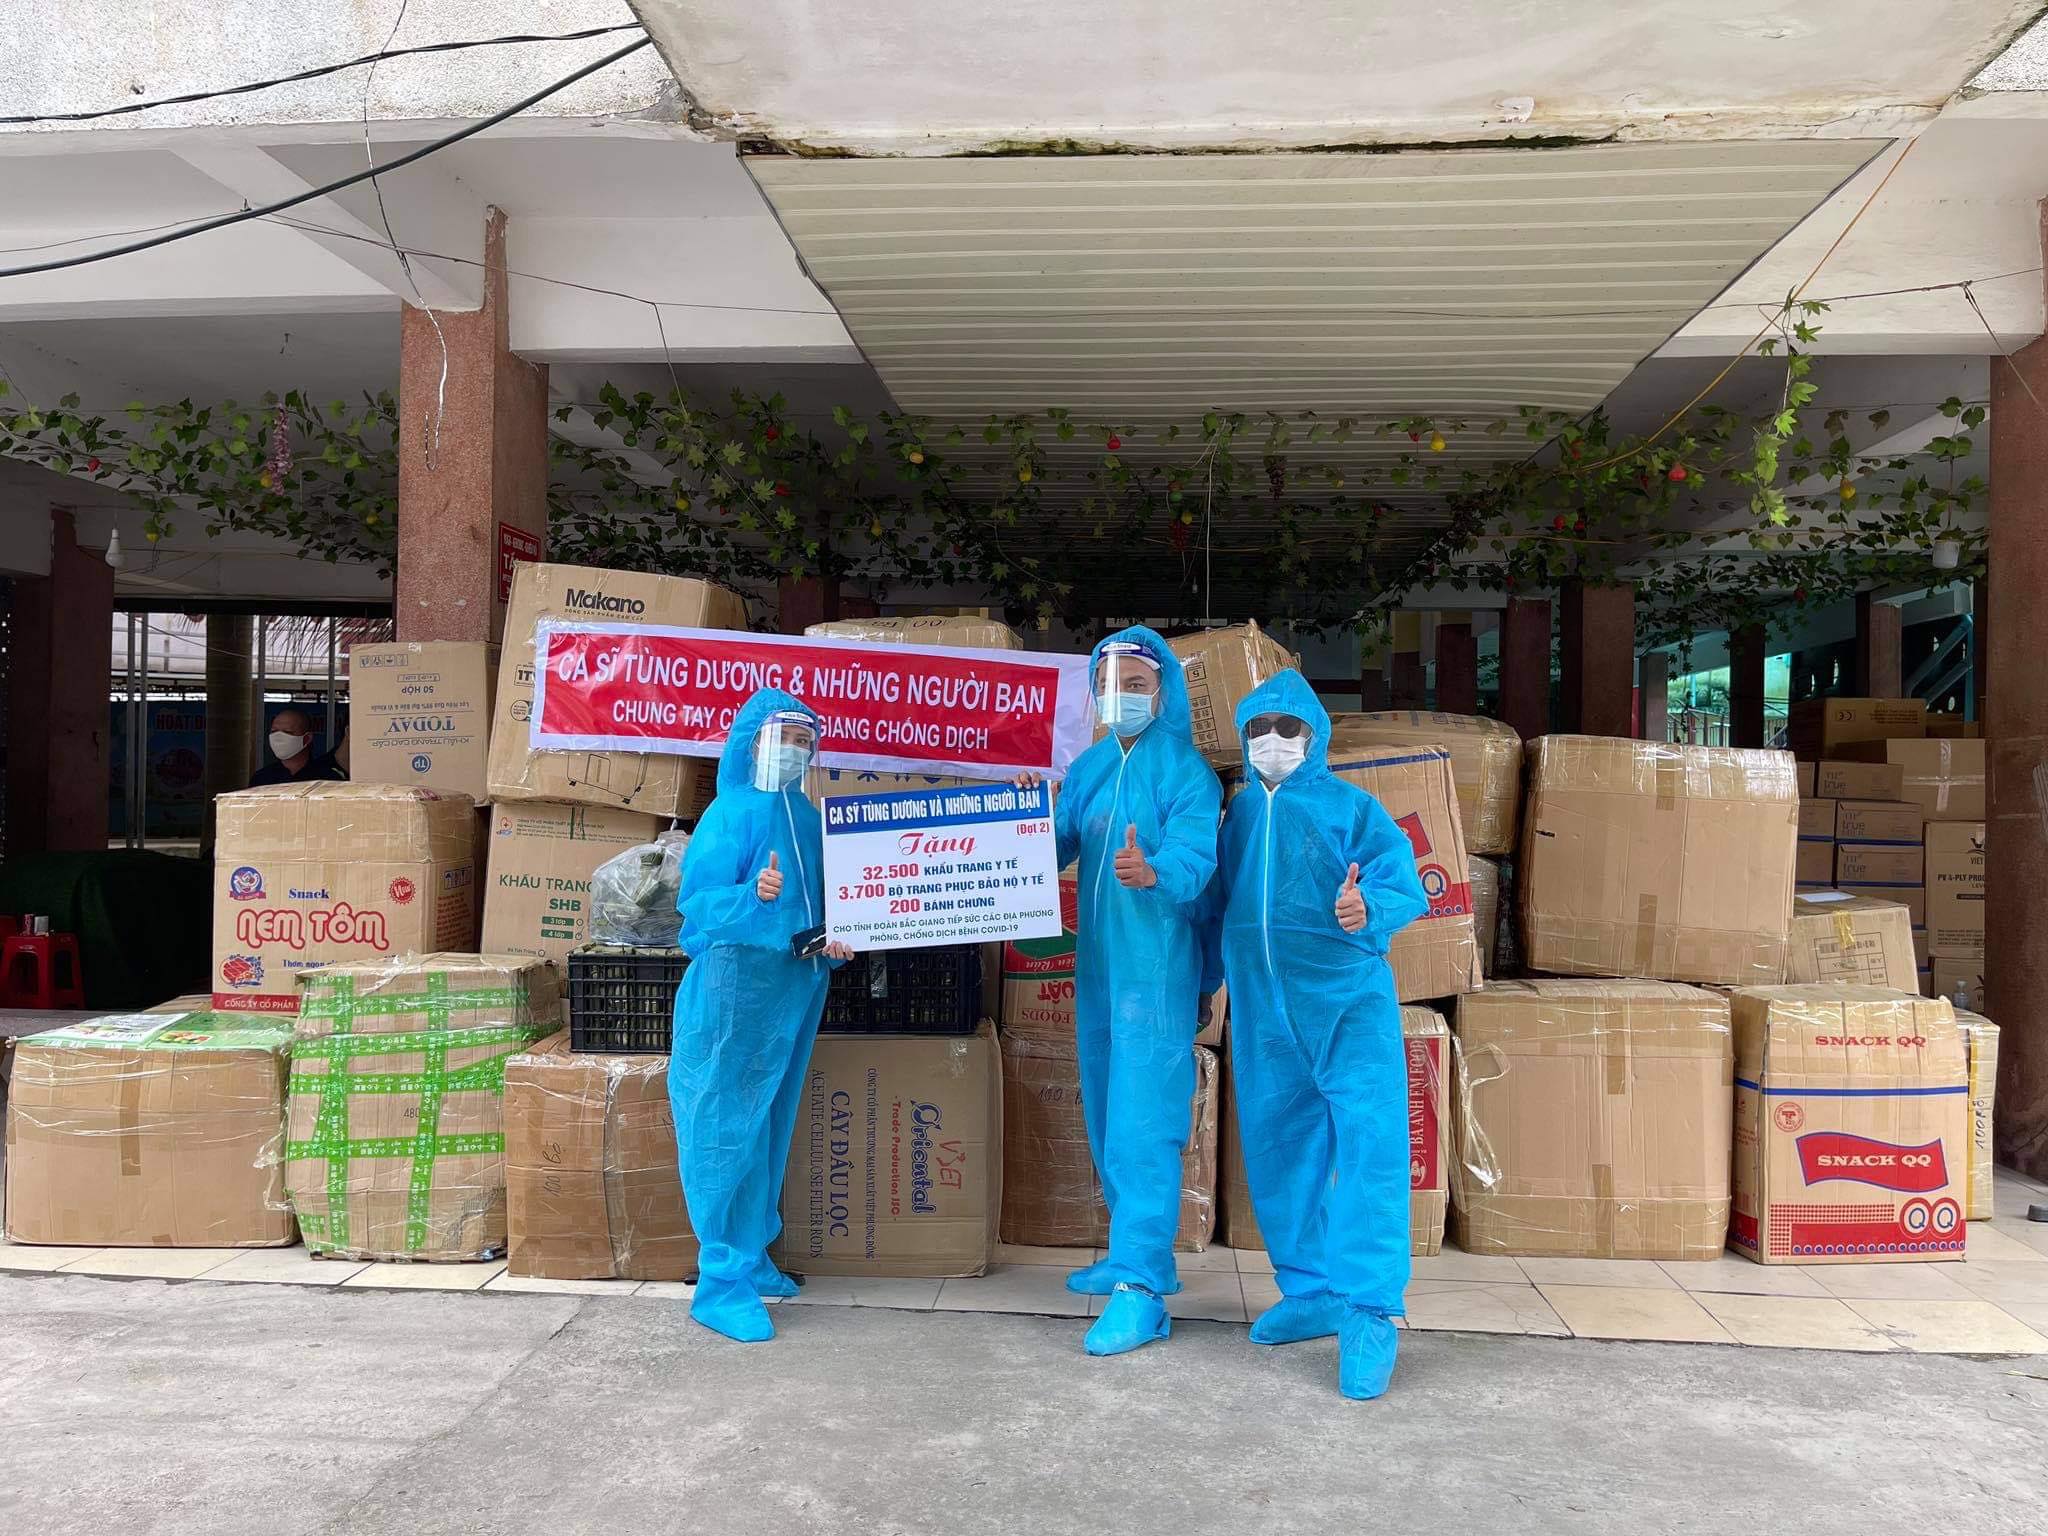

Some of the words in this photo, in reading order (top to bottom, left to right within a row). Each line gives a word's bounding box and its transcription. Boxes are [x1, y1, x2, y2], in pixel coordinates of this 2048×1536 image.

[566, 588, 645, 615] Makano
[401, 684, 421, 694] HỘP
[424, 686, 434, 694] 50
[558, 652, 589, 682] CA
[595, 646, 620, 682] SĨ
[624, 647, 689, 688] TÙNG
[696, 658, 784, 694] DƯƠNG
[789, 665, 805, 696] &
[812, 662, 901, 704] NHỮNG
[907, 672, 989, 712] NGƯỜI
[995, 682, 1046, 720] BẠN
[388, 716, 455, 733] TODAY
[612, 700, 677, 726] CHUNG
[682, 704, 718, 730] TAY
[817, 714, 870, 742] GIANG
[875, 717, 940, 748] CHỐNG
[945, 726, 989, 754] DỊCH
[829, 806, 844, 825] CA
[847, 802, 860, 824] SỸ
[862, 800, 890, 822] TÙNG
[892, 798, 928, 820] DƯƠNG
[929, 794, 944, 817] VÀ
[945, 792, 982, 816] NHỮNG
[984, 789, 1017, 812] NGƯỜI
[1018, 790, 1041, 813] BẠN
[1016, 824, 1038, 836] (Đợt
[1040, 822, 1050, 834] 2)
[898, 832, 978, 858] Tặng
[500, 874, 540, 888] KHẨU
[862, 862, 919, 881] 32.500
[924, 862, 954, 877] KHẨU
[956, 861, 992, 875] TRANG
[996, 860, 1004, 870] Y
[1006, 856, 1018, 870] TẾ
[288, 888, 330, 900] Snack
[392, 880, 412, 899] New
[838, 882, 886, 901] 3.700
[888, 884, 904, 898] BỘ
[906, 882, 942, 896] TRANG
[945, 880, 975, 894] PHỤC
[978, 875, 1000, 892] BẢO
[1003, 874, 1019, 890] HỘ
[1021, 875, 1030, 886] Y
[1031, 872, 1044, 885] TẾ
[549, 898, 582, 912] SHB
[890, 898, 921, 915] 200
[924, 898, 954, 912] BÁNH
[957, 896, 996, 910] CHƯNG
[308, 901, 390, 951] TÔM
[833, 924, 852, 934] CHO
[854, 920, 872, 932] TỈNH
[874, 918, 898, 932] ĐOÀN
[900, 914, 918, 929] BẮC
[918, 916, 946, 928] GIANG
[947, 912, 964, 926] TIẾP
[964, 911, 982, 924] SỨC
[982, 910, 1002, 922] CÁC
[1003, 909, 1018, 922] ĐỊA
[1020, 908, 1054, 921] PHƯƠNG
[870, 930, 902, 943] PHÒNG,
[903, 927, 934, 940] CHỐNG
[936, 928, 956, 940] DỊCH
[958, 924, 980, 938] BỆNH
[980, 924, 1020, 936] COVID-19
[224, 998, 247, 1010] CÔNG
[249, 998, 258, 1010] TY
[259, 998, 272, 1010] CỔ
[272, 998, 294, 1010] PHẦN
[1037, 980, 1075, 1004] UẬT
[1021, 1010, 1071, 1024] FOODS
[1815, 1035, 1890, 1046] SNACK
[1896, 1036, 1926, 1048] QQ
[1410, 1040, 1425, 1074] FOOD
[866, 1068, 878, 1088] CÔNG
[1409, 1078, 1425, 1096] EM
[811, 1070, 824, 1120] ACETATE
[830, 1090, 854, 1135] CÂY
[891, 1102, 900, 1134] Trade
[1409, 1100, 1424, 1126] ANH
[810, 1122, 824, 1189] CELLULOSE
[830, 1140, 855, 1188] ĐẦU
[891, 1136, 900, 1195] Production
[910, 1100, 943, 1216] Oriental
[1817, 1155, 1896, 1166] SNACK
[1901, 1155, 1932, 1168] QQ
[810, 1190, 823, 1228] FILTER
[826, 1192, 848, 1238] LỌC
[890, 1198, 900, 1216] JSC
[810, 1228, 823, 1259] RODS
